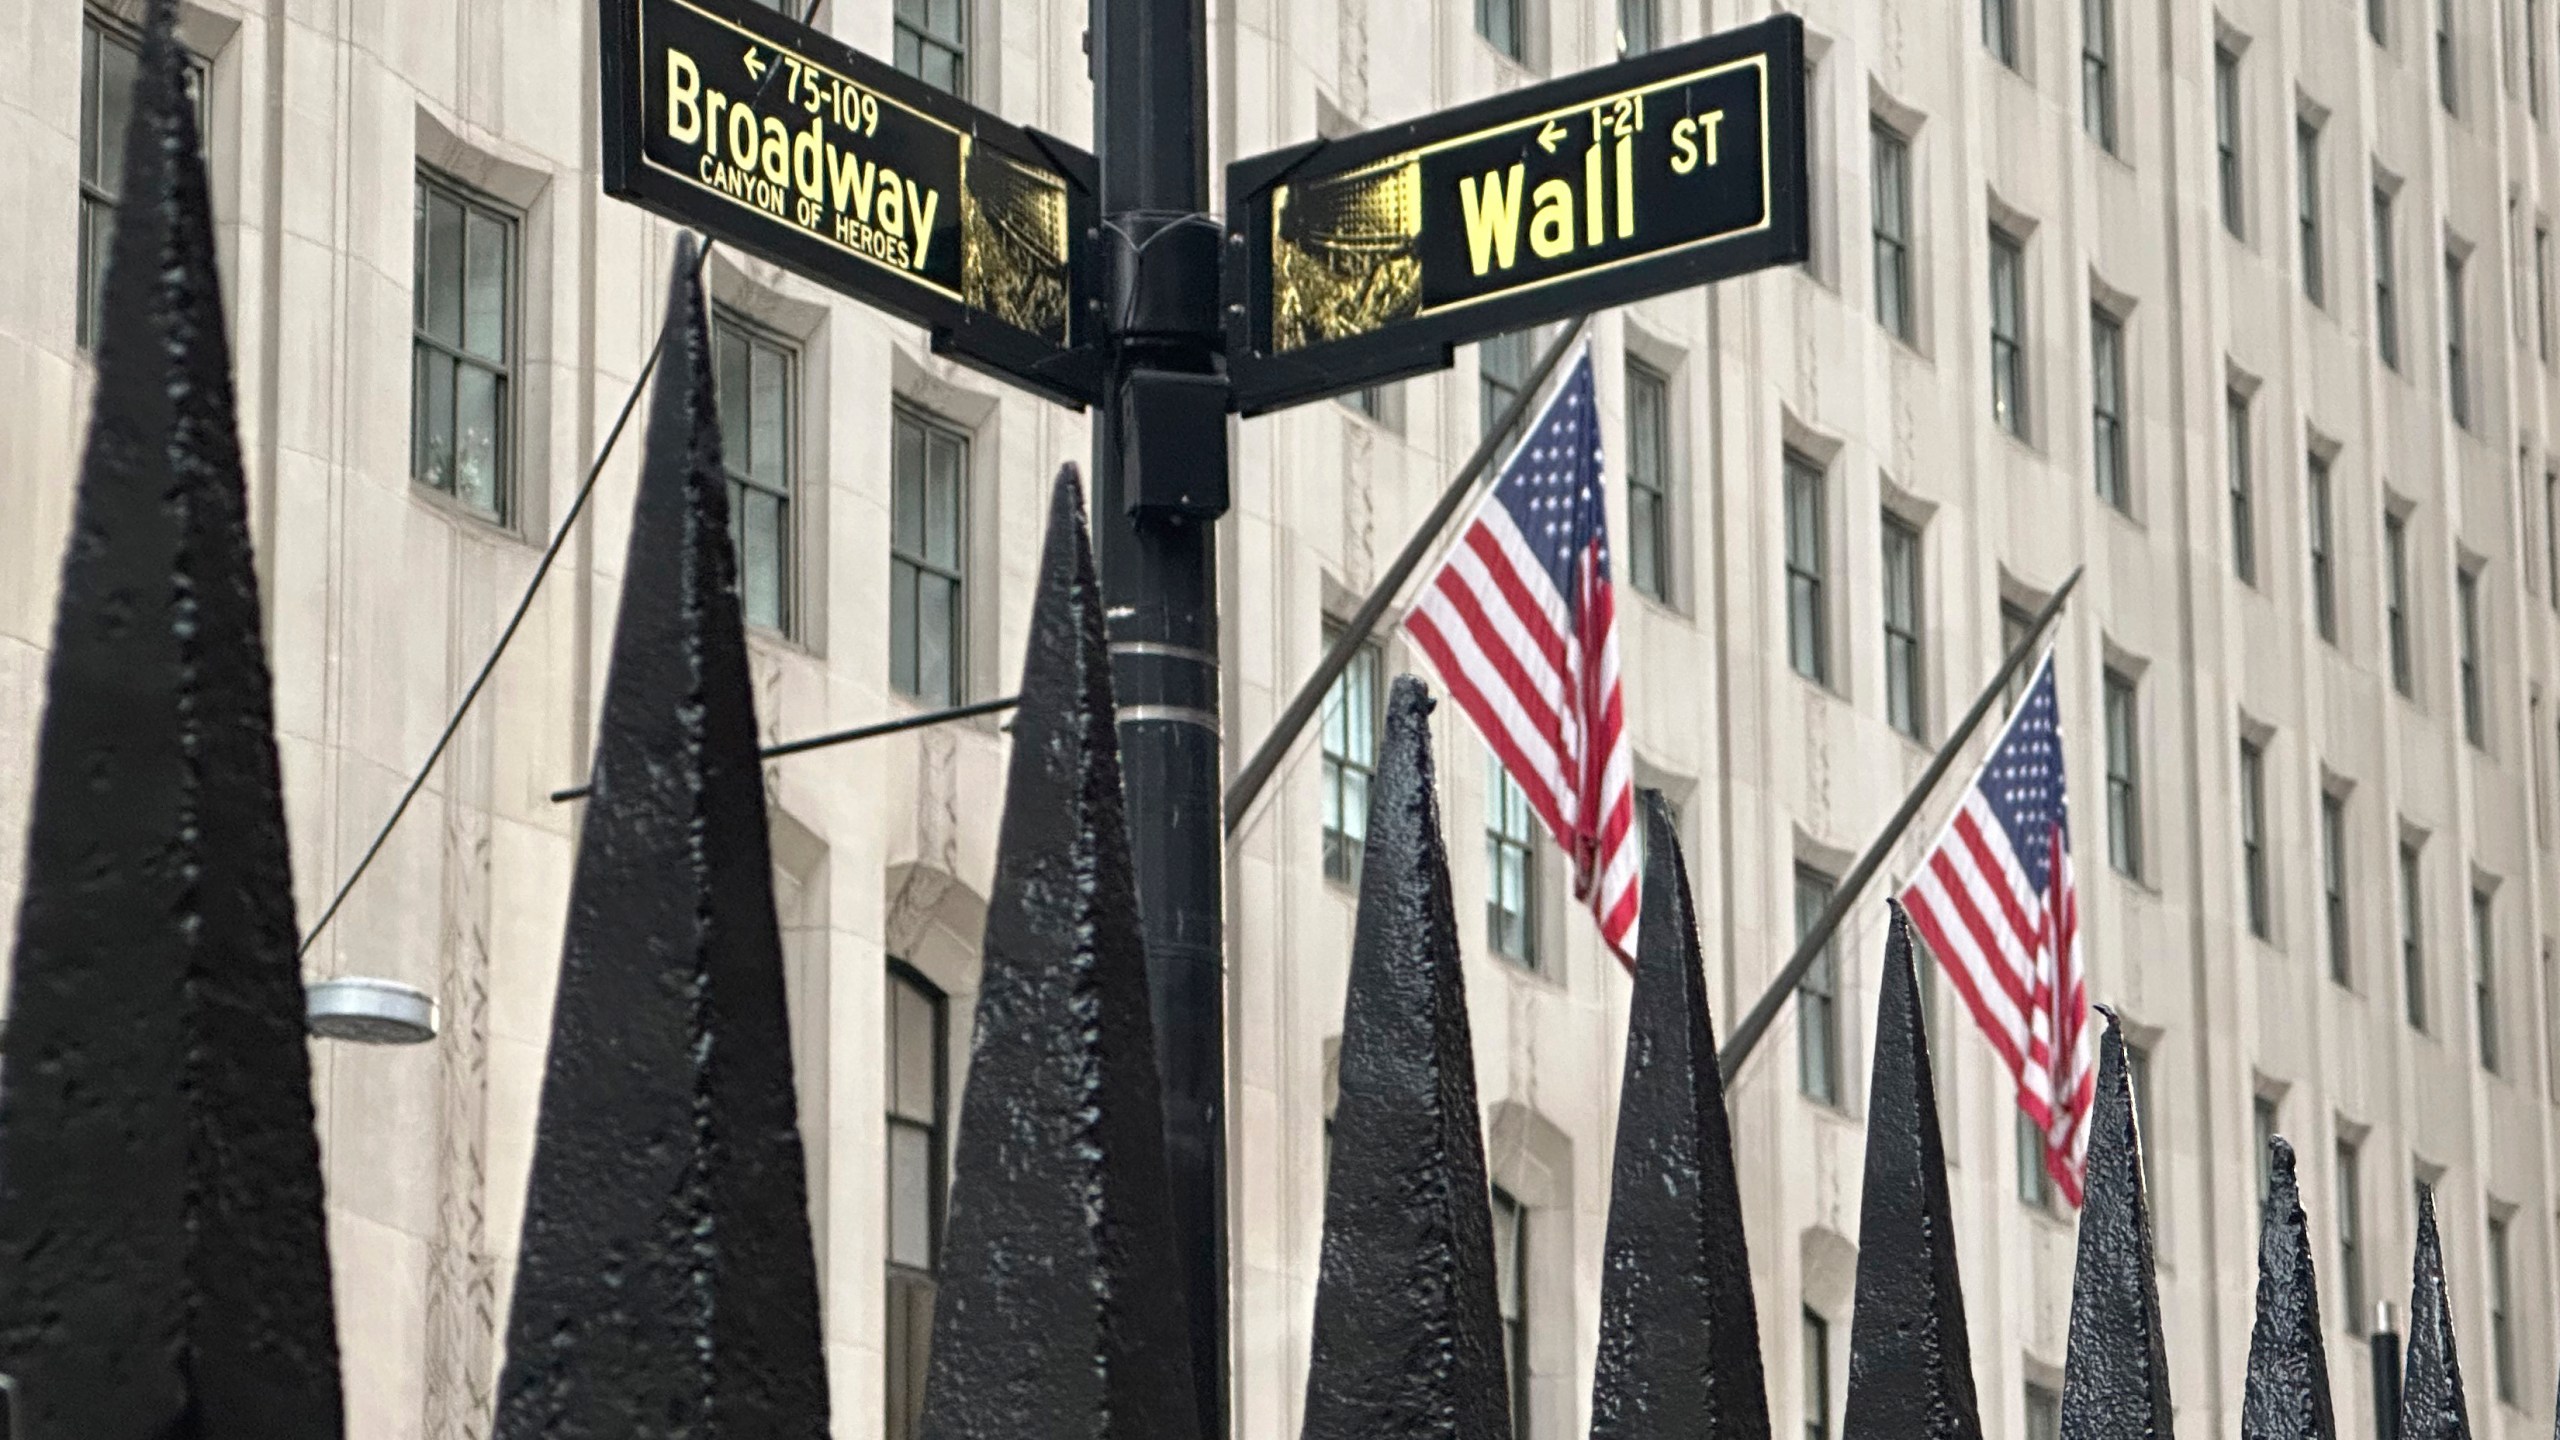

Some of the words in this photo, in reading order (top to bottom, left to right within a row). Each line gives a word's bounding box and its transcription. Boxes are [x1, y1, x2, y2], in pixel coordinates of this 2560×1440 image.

[784, 57, 879, 139] 75-109
[1592, 94, 1644, 141] 1-21
[667, 47, 939, 271] Broadway
[699, 152, 785, 216] CANYON
[797, 196, 824, 231] OF
[835, 214, 910, 271] HEROES
[1459, 134, 1634, 277] Wall
[1670, 111, 1723, 174] ST
